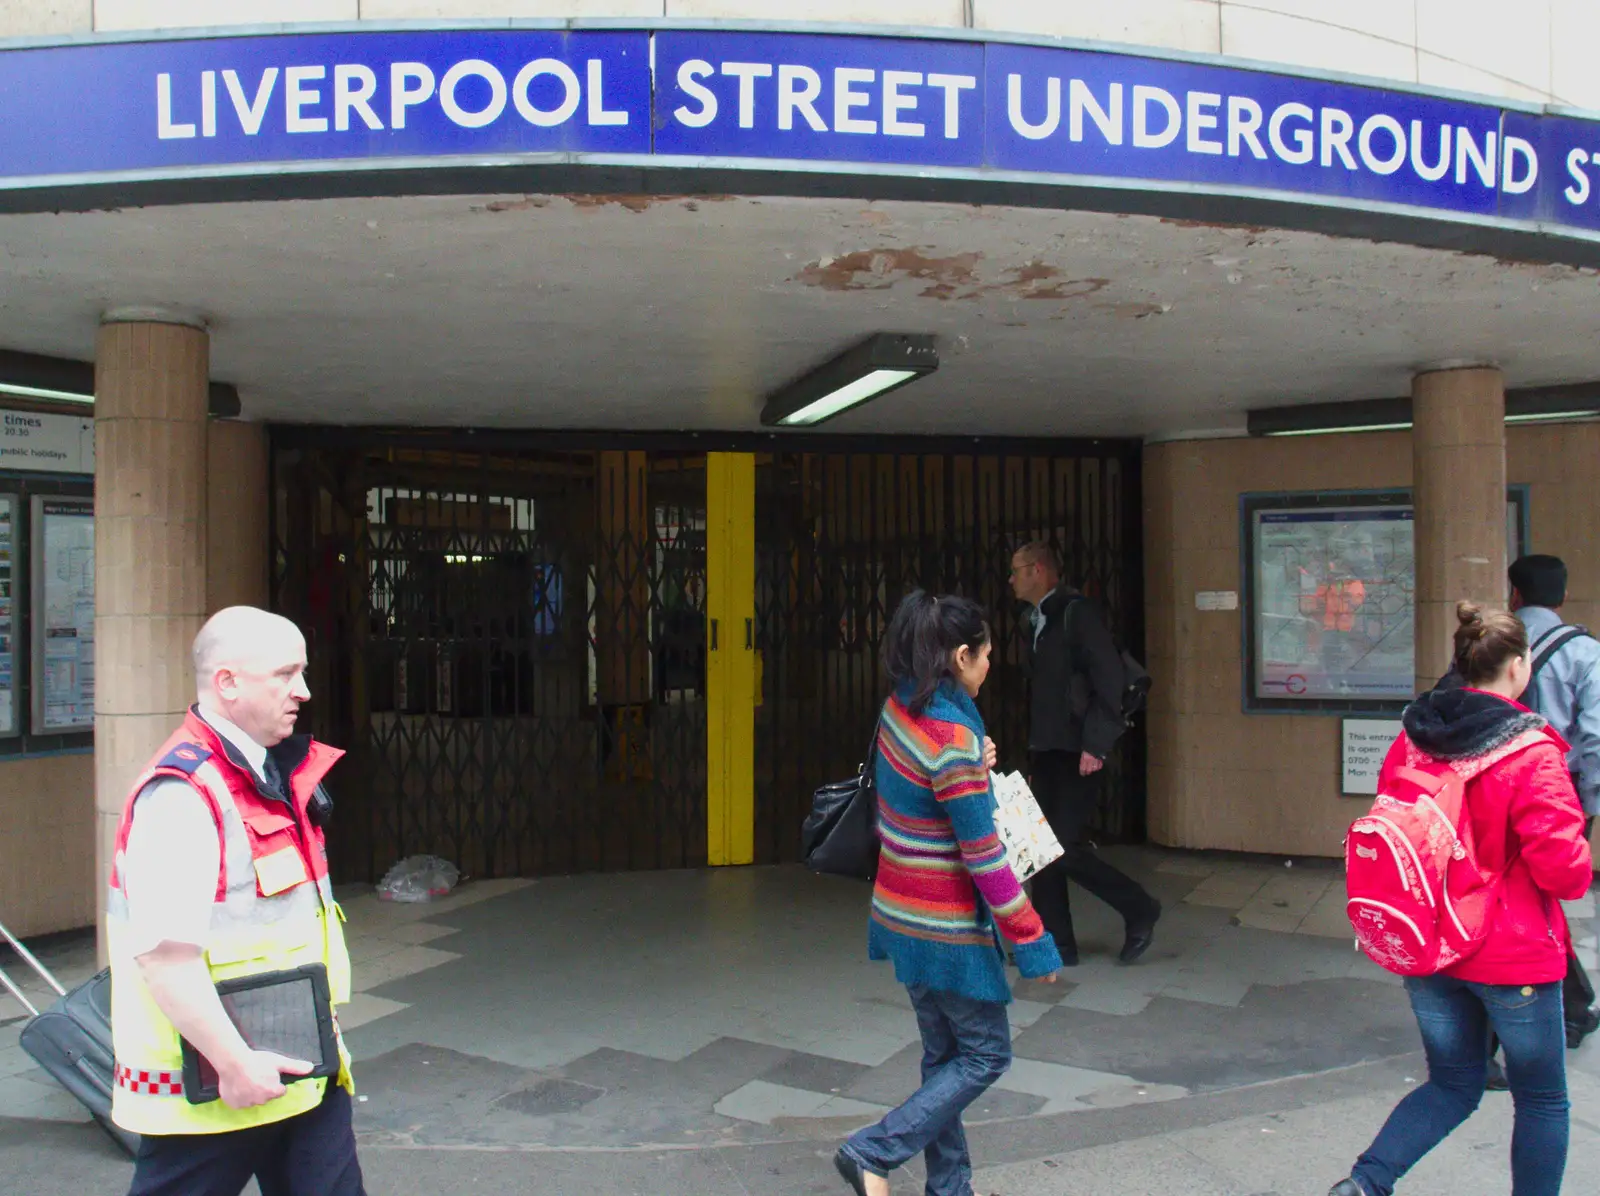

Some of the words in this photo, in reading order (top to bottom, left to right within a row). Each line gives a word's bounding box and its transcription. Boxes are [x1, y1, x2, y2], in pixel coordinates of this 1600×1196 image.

[156, 58, 629, 140] LIVERPOOL
[673, 59, 977, 140] STREET
[1007, 72, 1538, 194] UNDERGROUND
[4, 413, 42, 427] times
[0, 447, 29, 457] public
[30, 448, 68, 460] holidays
[1348, 732, 1367, 740] This
[1348, 768, 1367, 776] Mon
